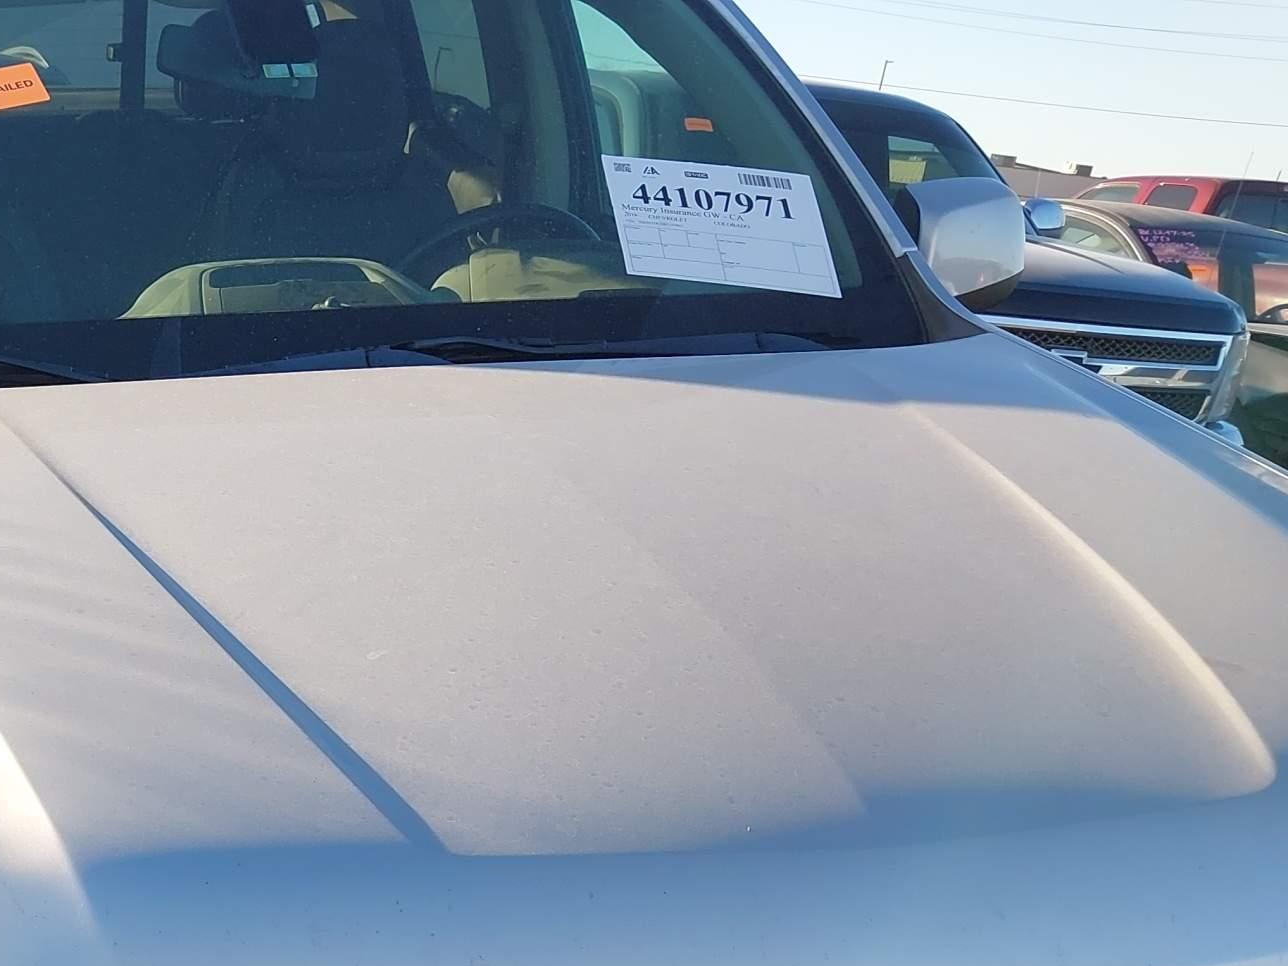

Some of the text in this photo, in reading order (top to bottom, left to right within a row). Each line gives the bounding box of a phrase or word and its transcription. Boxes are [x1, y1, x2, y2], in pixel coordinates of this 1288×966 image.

[621, 203, 657, 214] Mercury
[660, 205, 702, 217] Insurance
[729, 214, 745, 222] CA
[632, 183, 796, 220] 44107971
